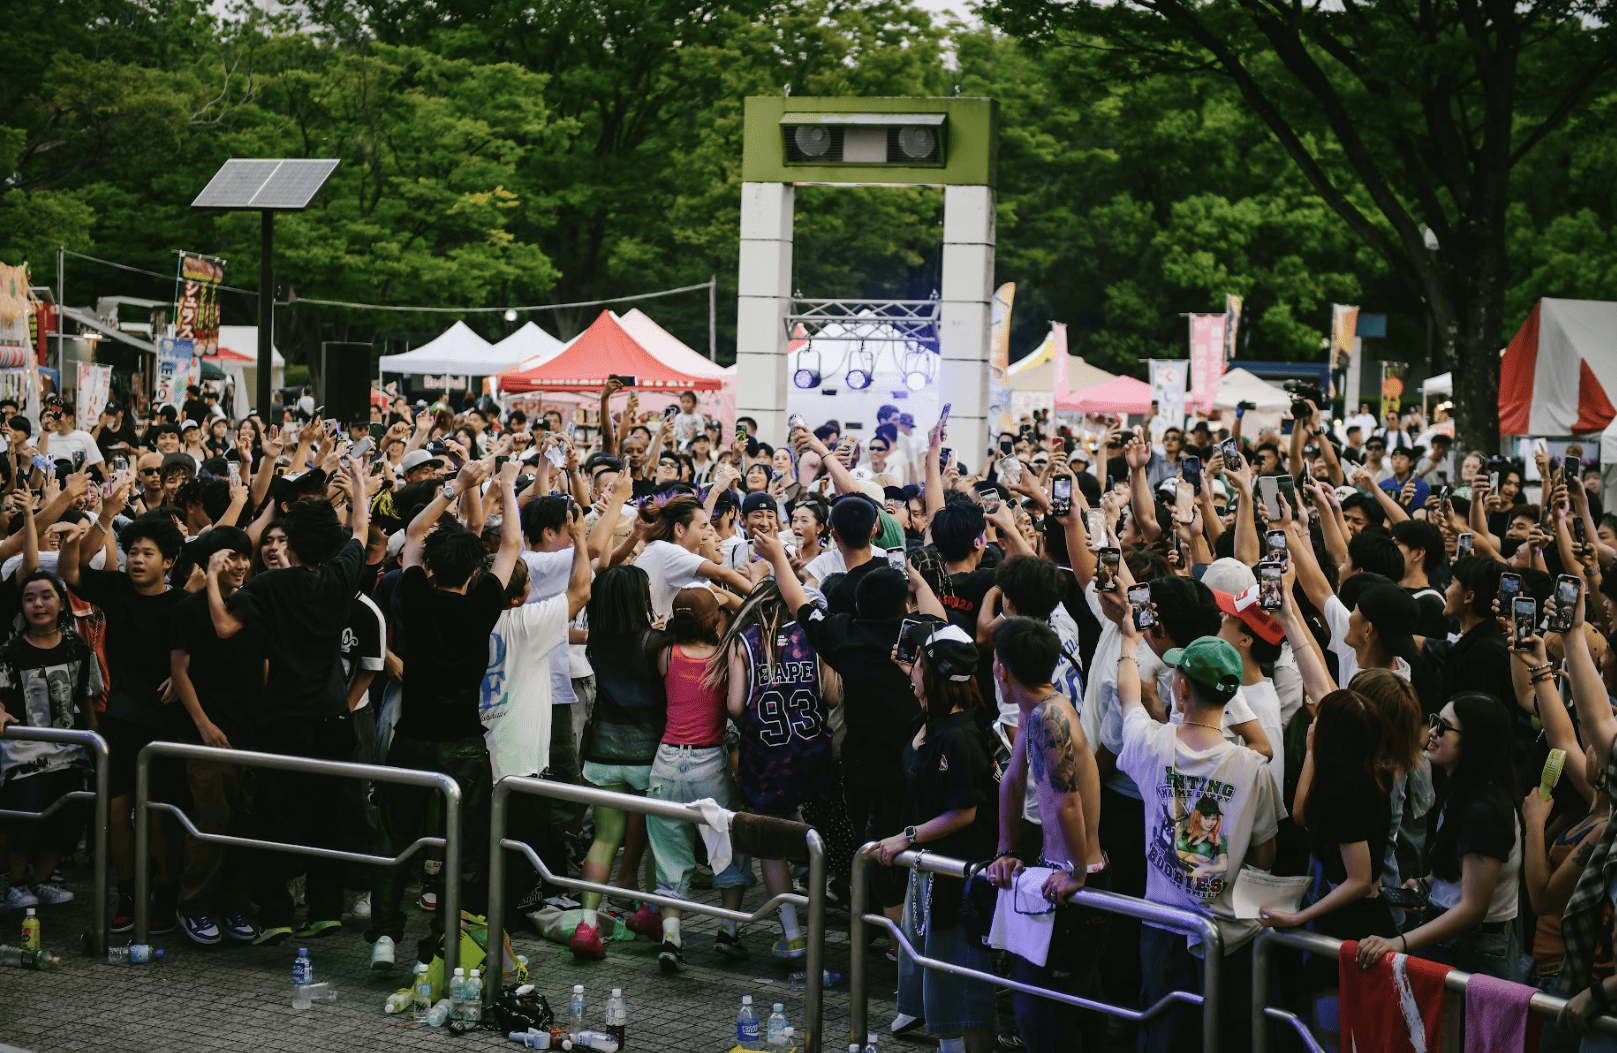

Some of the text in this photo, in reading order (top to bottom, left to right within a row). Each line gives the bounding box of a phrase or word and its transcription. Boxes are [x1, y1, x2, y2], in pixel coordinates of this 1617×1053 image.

[758, 661, 814, 686] BAPE
[757, 688, 824, 747] 93
[1165, 766, 1236, 798] HNTING
[1147, 845, 1224, 893] BOOBIES
